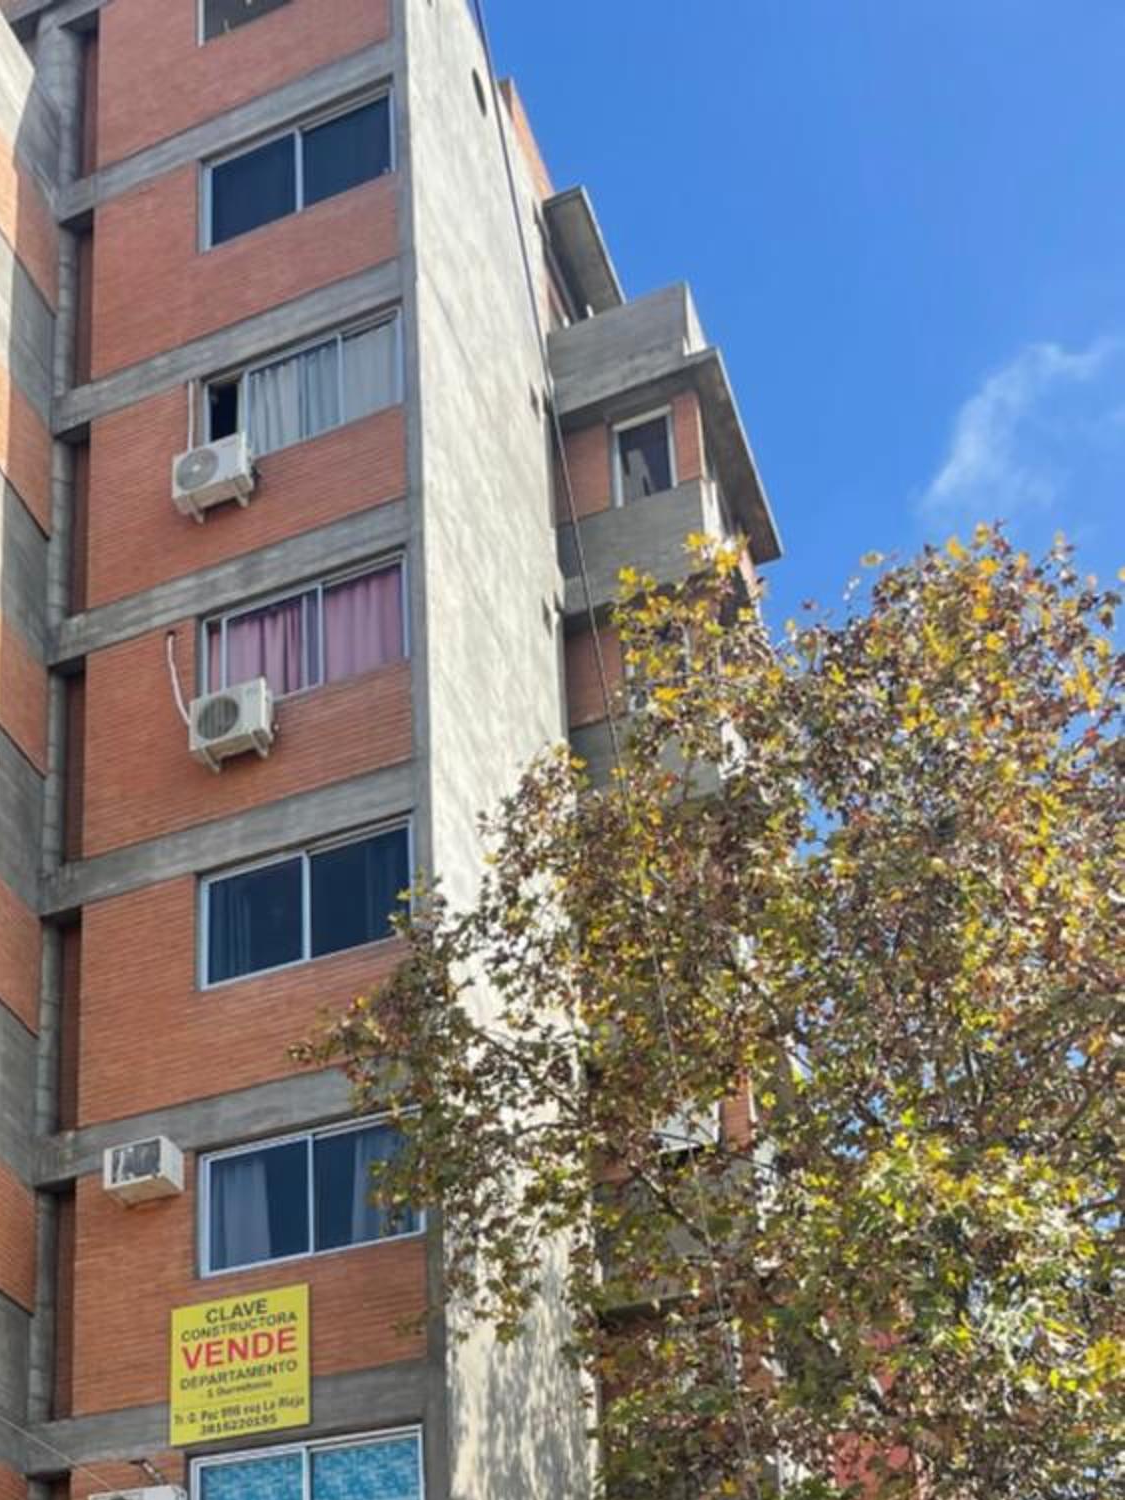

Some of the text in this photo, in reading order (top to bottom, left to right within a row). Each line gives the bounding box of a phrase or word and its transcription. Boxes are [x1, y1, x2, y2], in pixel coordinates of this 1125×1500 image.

[180, 1311, 298, 1342] CONSTRUCTORA
[205, 1298, 267, 1324] CLAVE
[180, 1326, 298, 1370] VENDE
[179, 1359, 298, 1390] DEPARTAMENTO
